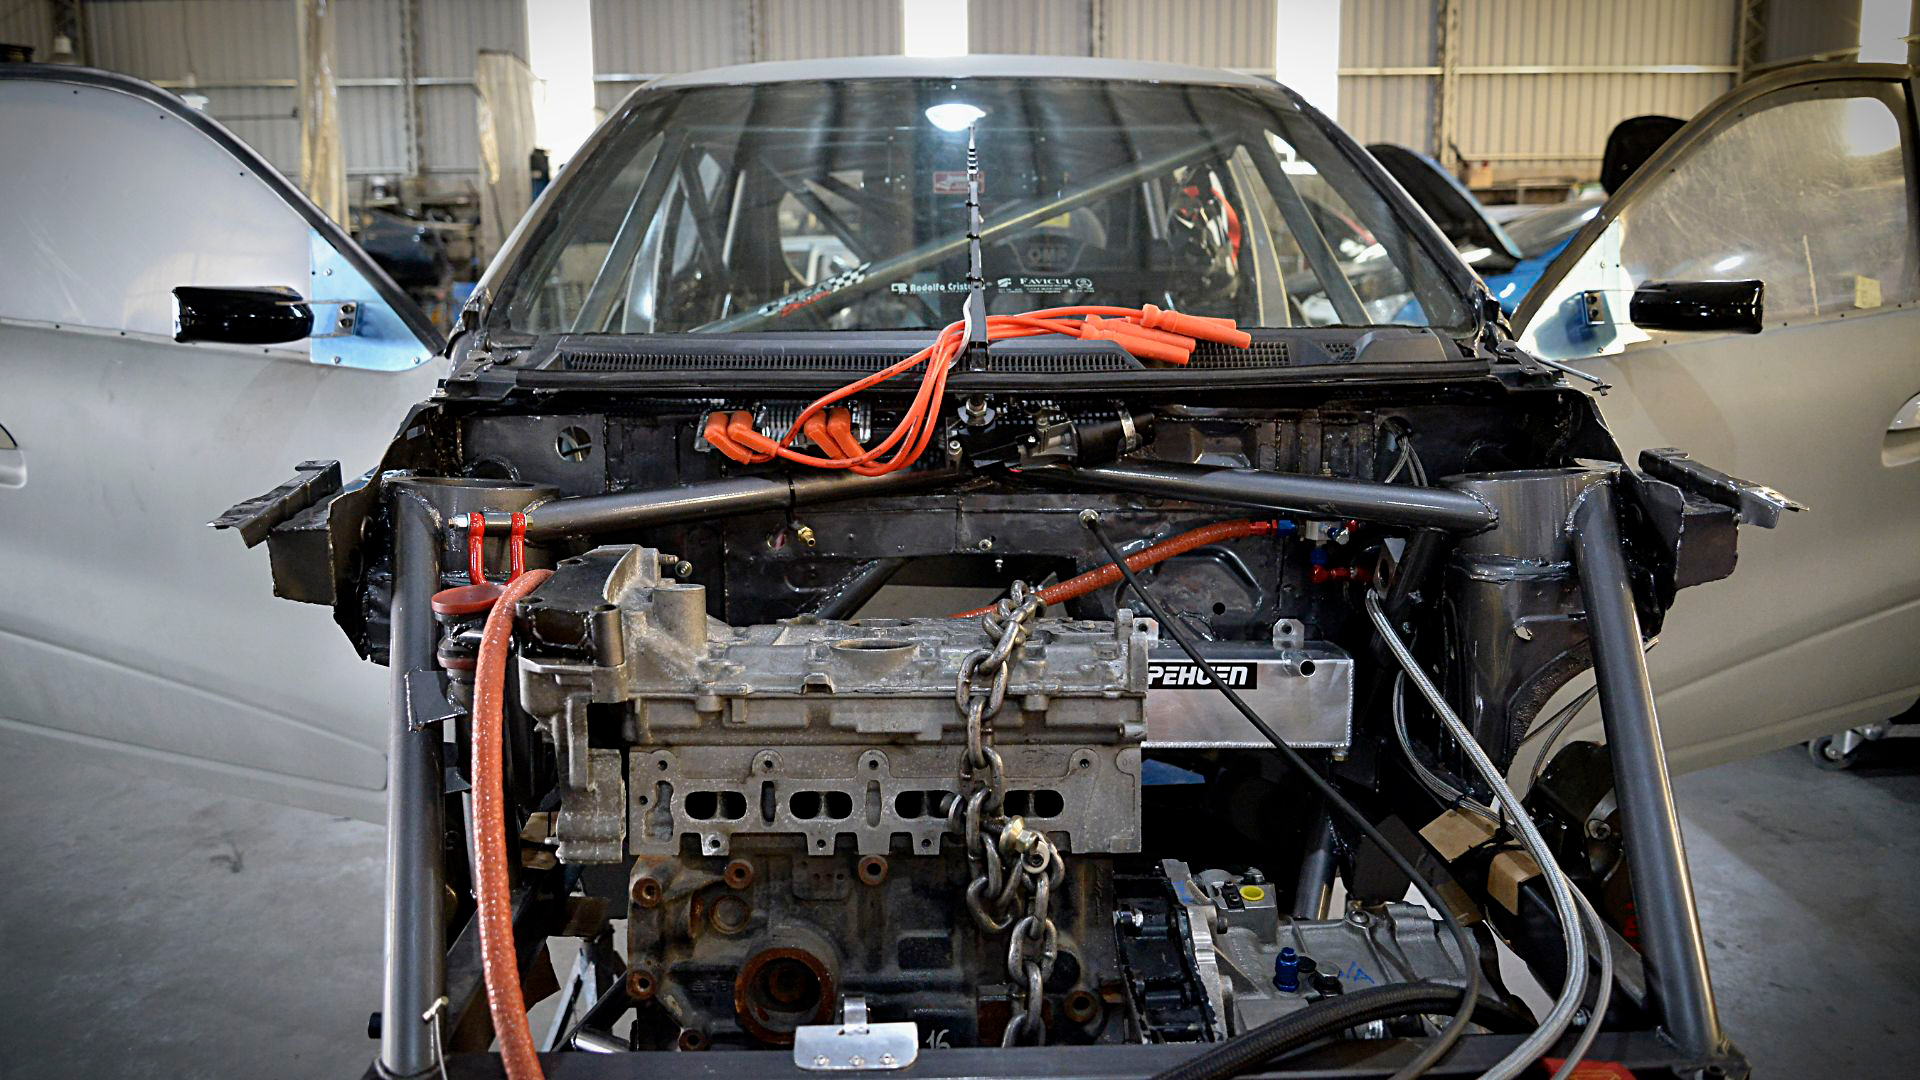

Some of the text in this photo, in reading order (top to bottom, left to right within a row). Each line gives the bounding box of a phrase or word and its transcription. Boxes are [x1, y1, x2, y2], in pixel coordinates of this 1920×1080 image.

[1019, 277, 1072, 285] FAVICUR
[909, 283, 945, 292] Rodolfo
[925, 1029, 951, 1049] 16
